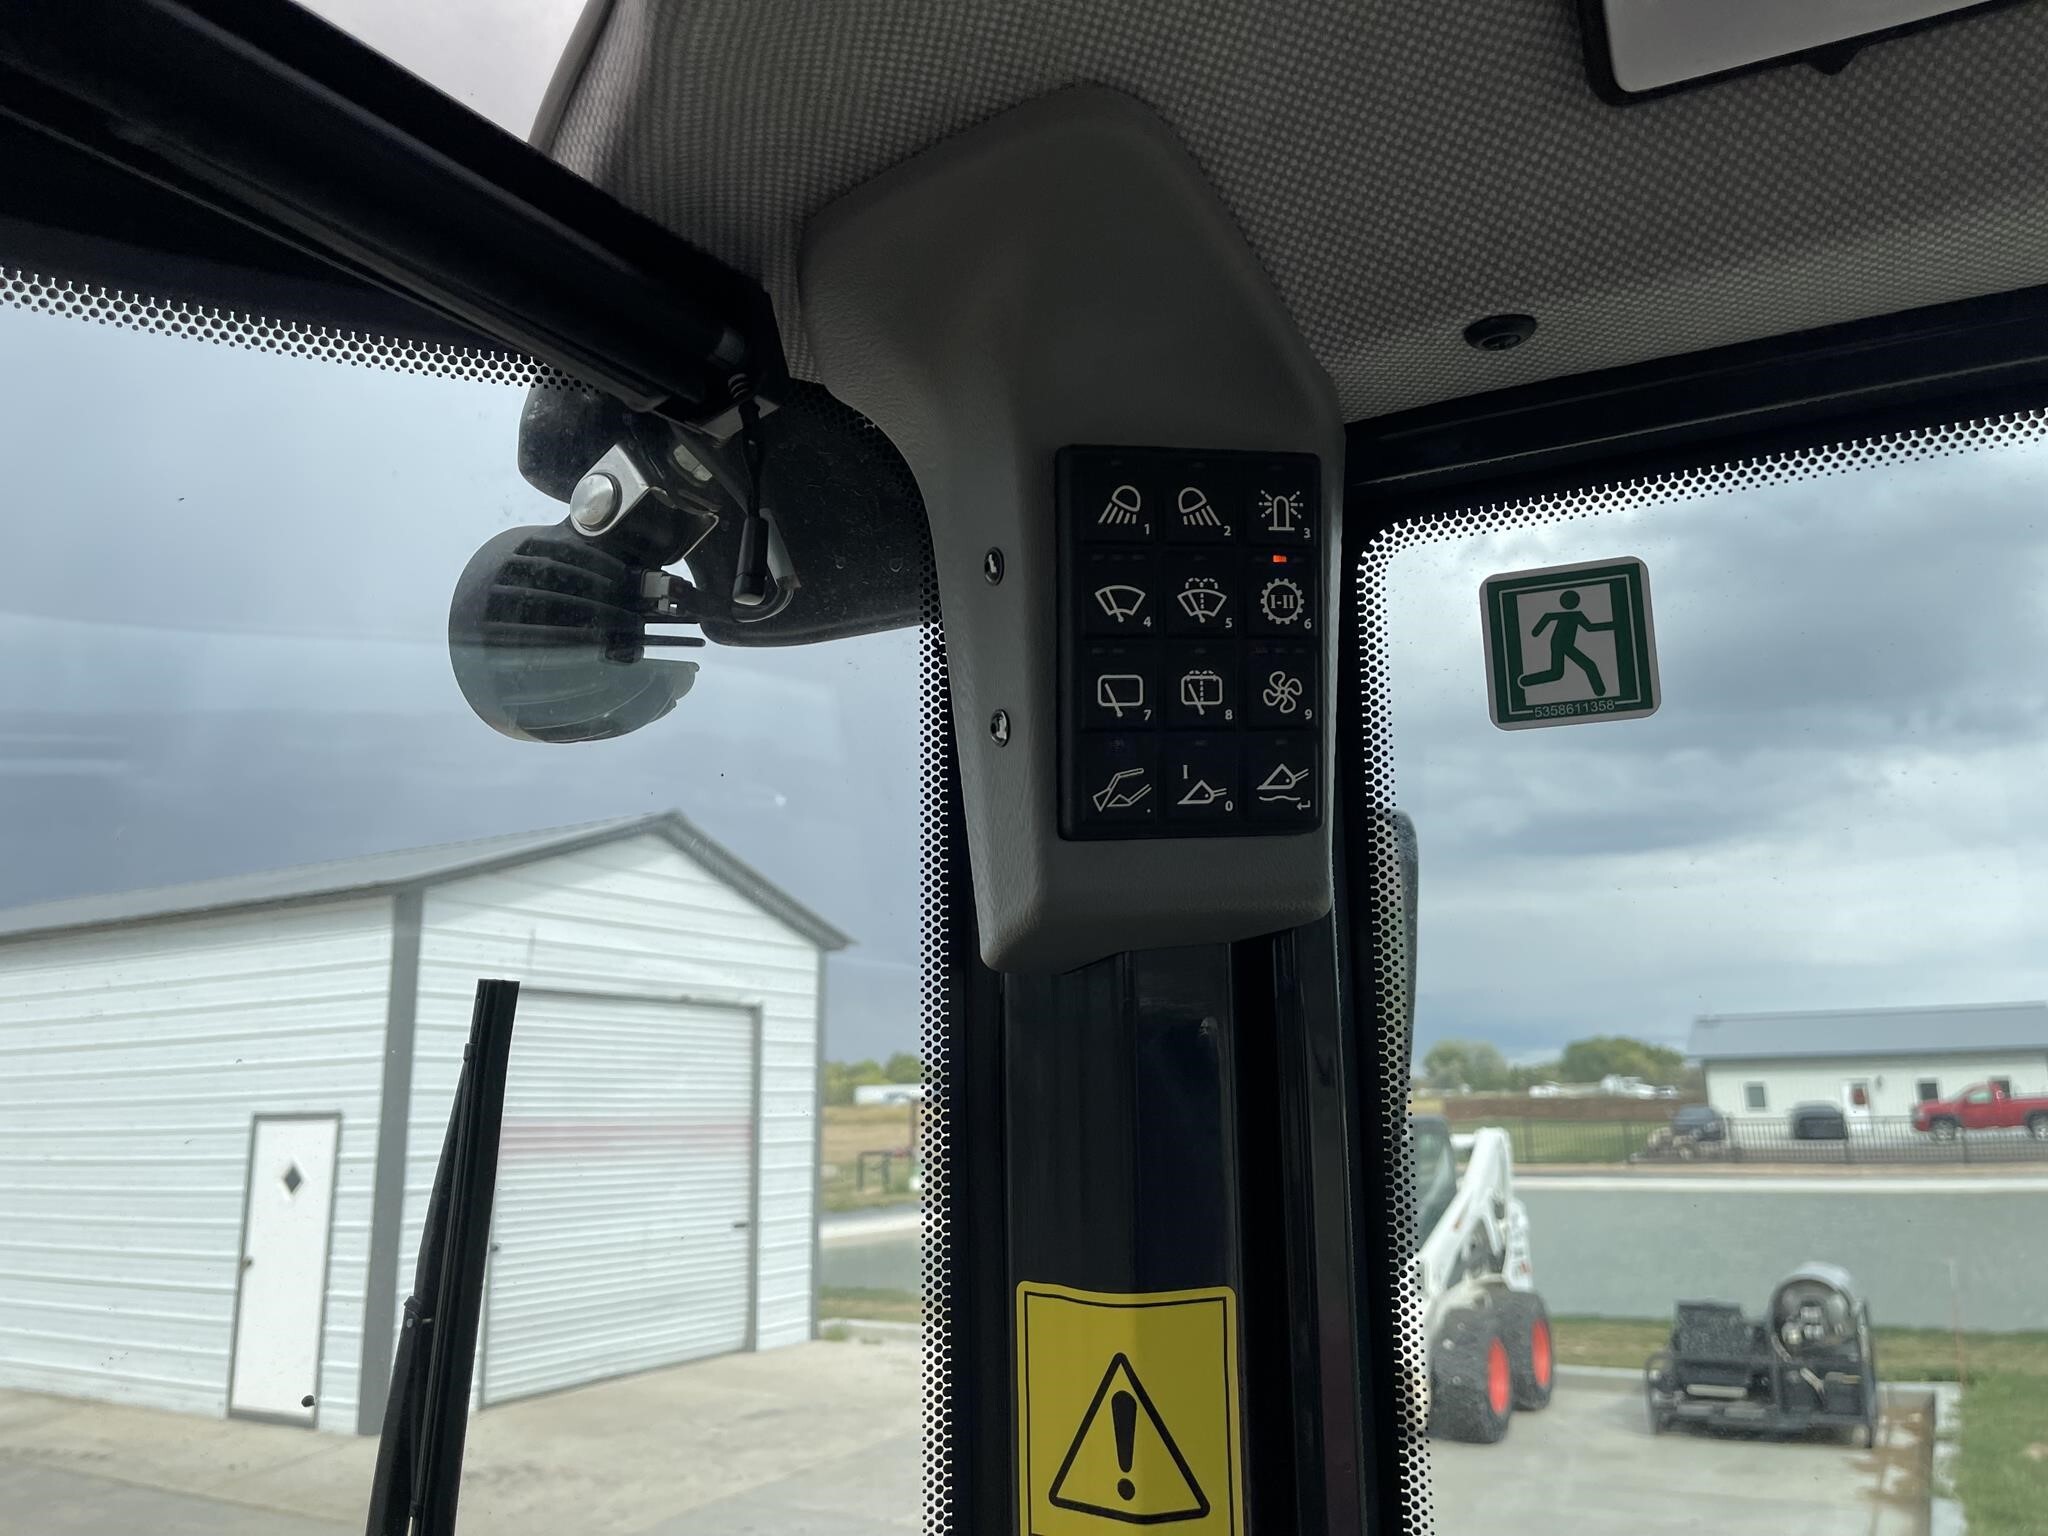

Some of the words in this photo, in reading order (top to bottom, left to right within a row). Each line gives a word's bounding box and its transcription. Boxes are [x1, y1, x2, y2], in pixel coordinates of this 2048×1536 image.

[1144, 523, 1150, 535] 1
[1223, 525, 1232, 536] 2
[1303, 528, 1311, 539] 3
[1143, 616, 1152, 627] 4
[1224, 617, 1233, 628] 5
[1303, 618, 1312, 629] 6
[1143, 709, 1152, 720] 7
[1224, 709, 1233, 720] 8
[1304, 709, 1313, 720] 9
[1534, 700, 1615, 718] 5358611358
[1225, 801, 1233, 812] 0
